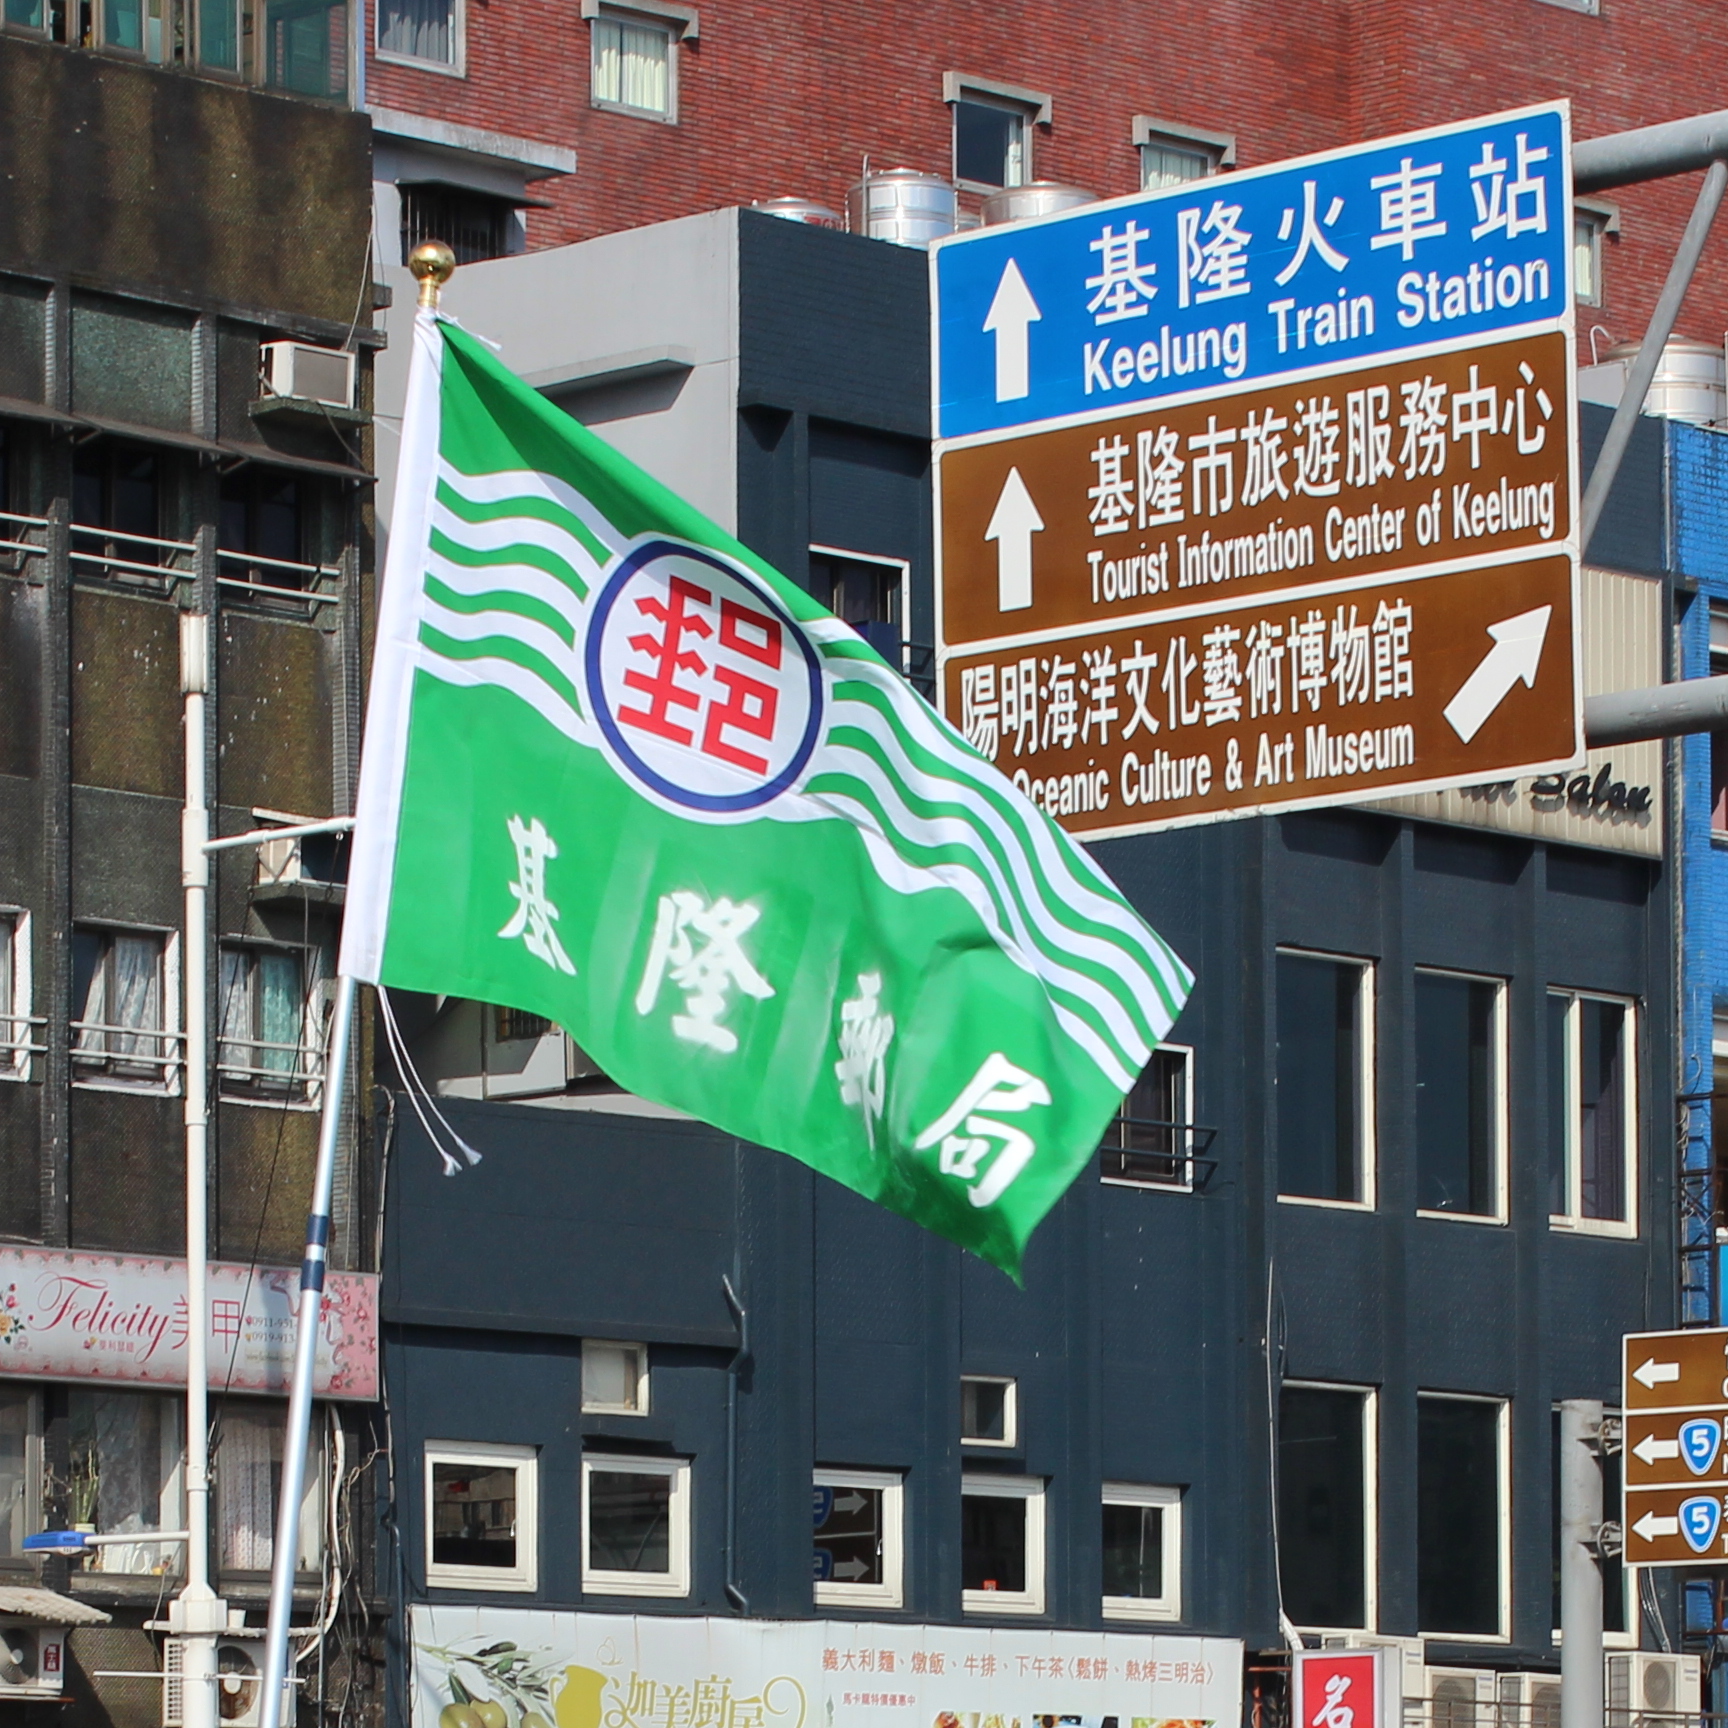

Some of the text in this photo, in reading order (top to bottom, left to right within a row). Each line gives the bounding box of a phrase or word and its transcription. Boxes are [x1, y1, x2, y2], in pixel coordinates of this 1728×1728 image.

[1084, 132, 1549, 326] 基隆火車站
[1083, 259, 1550, 396] Keelung Train Station
[1087, 360, 1553, 537] 基隆市旅遊服務中心
[1087, 476, 1555, 604] Tourist Information Center of Keelung
[961, 597, 1414, 763] 陽明海洋文化藝術博物館
[1013, 722, 1415, 813] Oceanic Culture & Art Museum
[497, 812, 1052, 1210] 基隆郵局
[27, 1270, 172, 1364] Felicity
[1688, 1428, 1711, 1458] 5
[1688, 1506, 1711, 1536] 5
